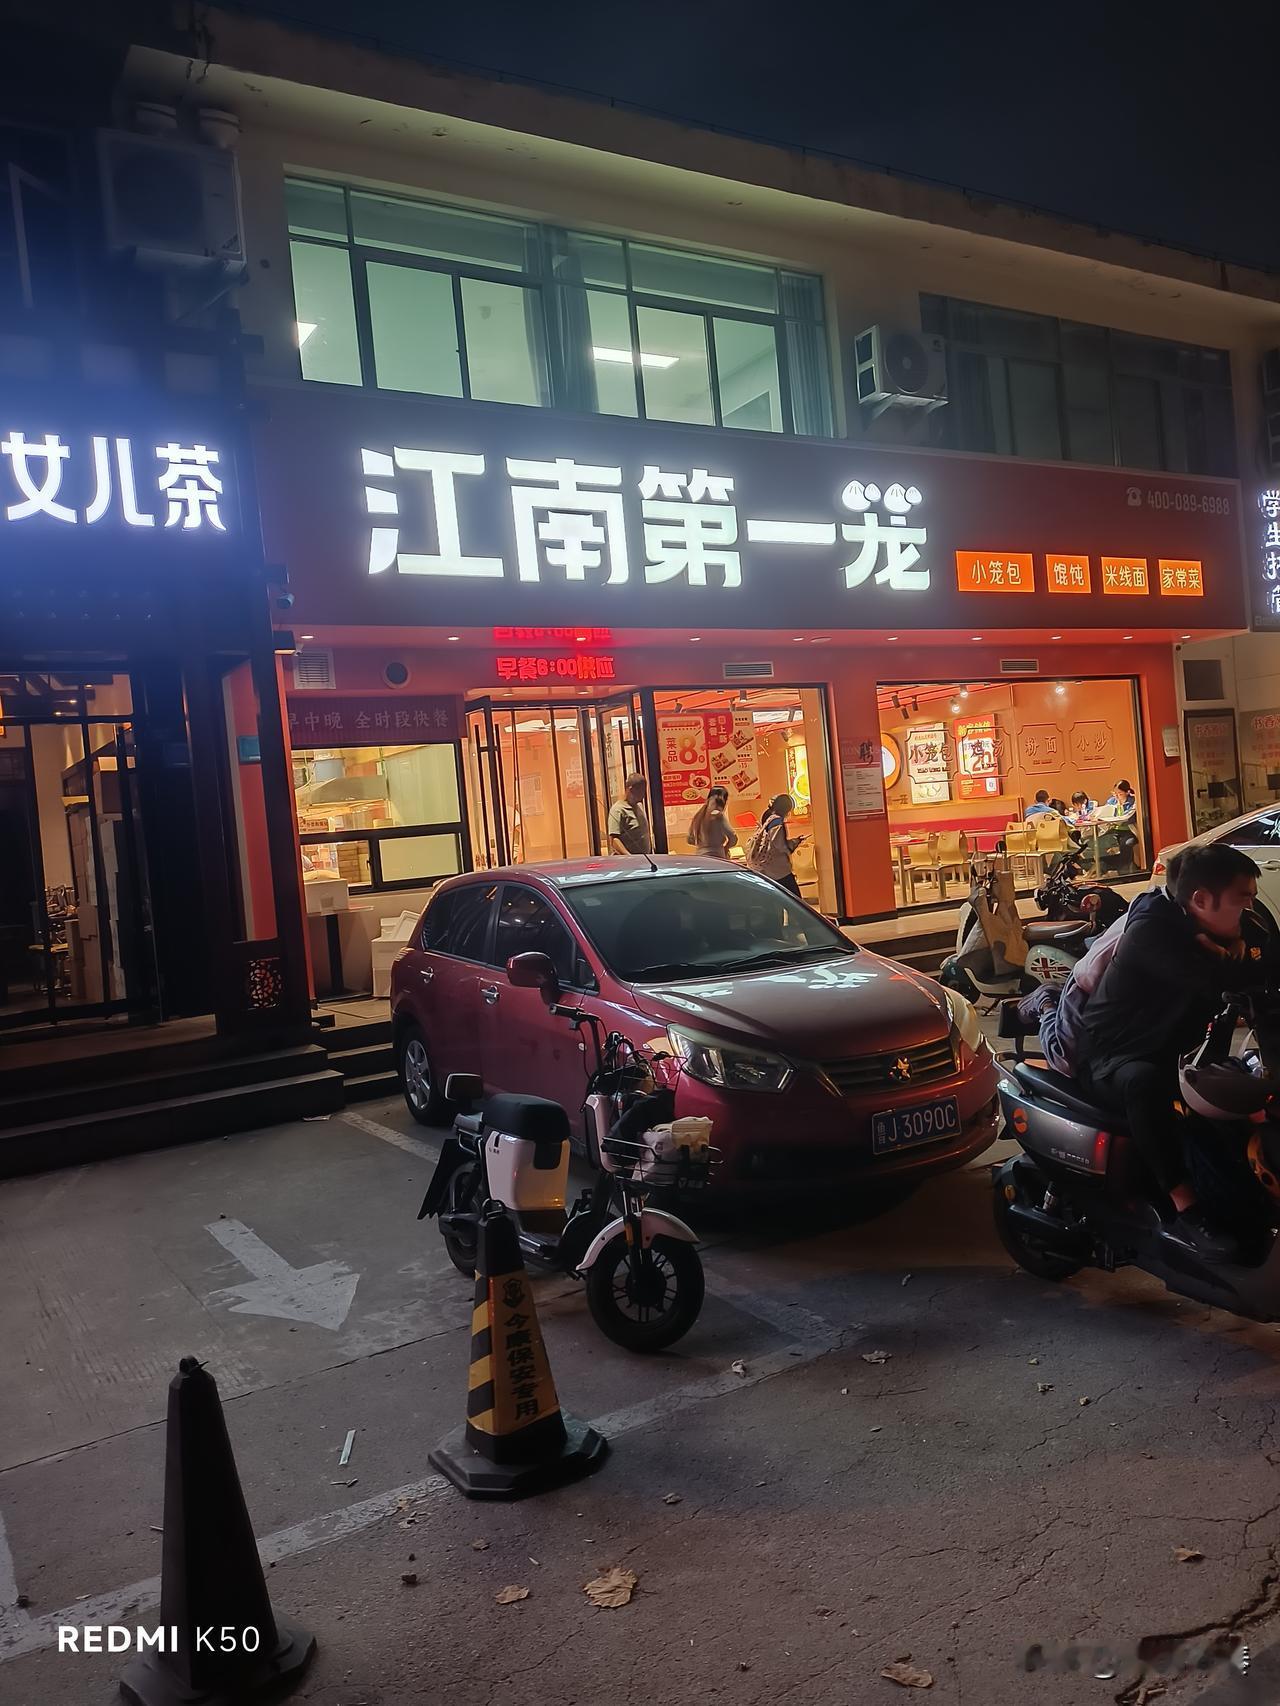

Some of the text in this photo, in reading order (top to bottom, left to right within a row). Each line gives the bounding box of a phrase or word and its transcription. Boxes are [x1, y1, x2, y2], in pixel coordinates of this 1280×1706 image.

[1, 431, 227, 531] 女儿茶
[1147, 489, 1231, 516] 400-089-6988
[360, 445, 931, 592] 江南第一笼
[970, 559, 1022, 585] 小笼包
[1053, 562, 1085, 586] 馄饨
[1105, 564, 1147, 588] 米线面
[1162, 567, 1201, 589] 家常菜
[355, 707, 449, 729] 全时段快餐
[679, 735, 699, 765] 8
